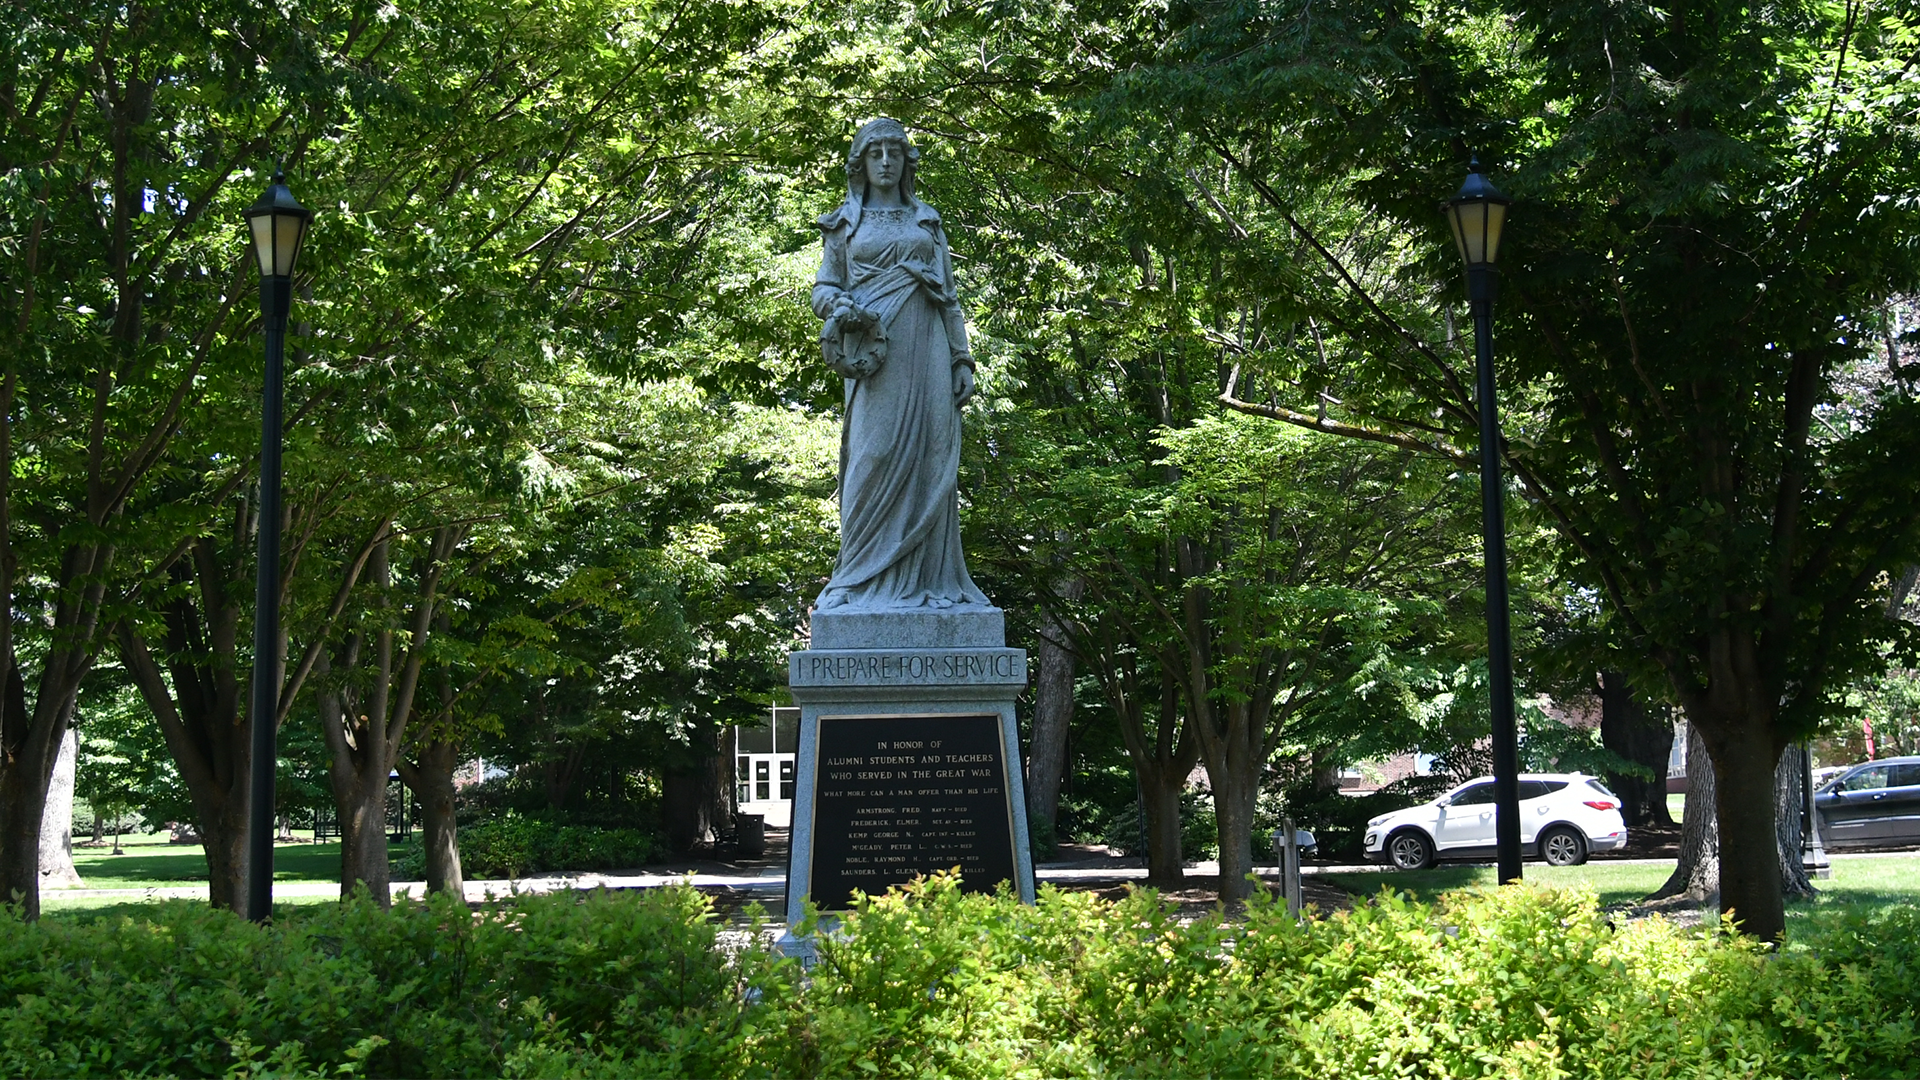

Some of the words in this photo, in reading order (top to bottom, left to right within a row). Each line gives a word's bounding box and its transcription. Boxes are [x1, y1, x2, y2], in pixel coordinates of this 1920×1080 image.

[798, 657, 801, 679] I
[811, 656, 892, 680] PREPARE
[899, 655, 937, 679] FOR
[943, 654, 1019, 678] SERVICE
[877, 741, 888, 750] IN
[893, 740, 924, 749] HONOR
[930, 740, 943, 749] OF
[827, 757, 863, 766] ALUMNI
[869, 755, 916, 765] STUDENTS
[921, 755, 941, 764] AND
[945, 753, 994, 763] TEACHERS
[830, 771, 853, 780] WHO
[857, 771, 893, 780] SERVED
[897, 770, 908, 779] IN
[912, 770, 932, 779] THE
[935, 769, 966, 778] GREAT
[971, 768, 992, 777] WAR
[873, 831, 900, 839] GEORGE
[874, 855, 906, 863] RAYMOND
